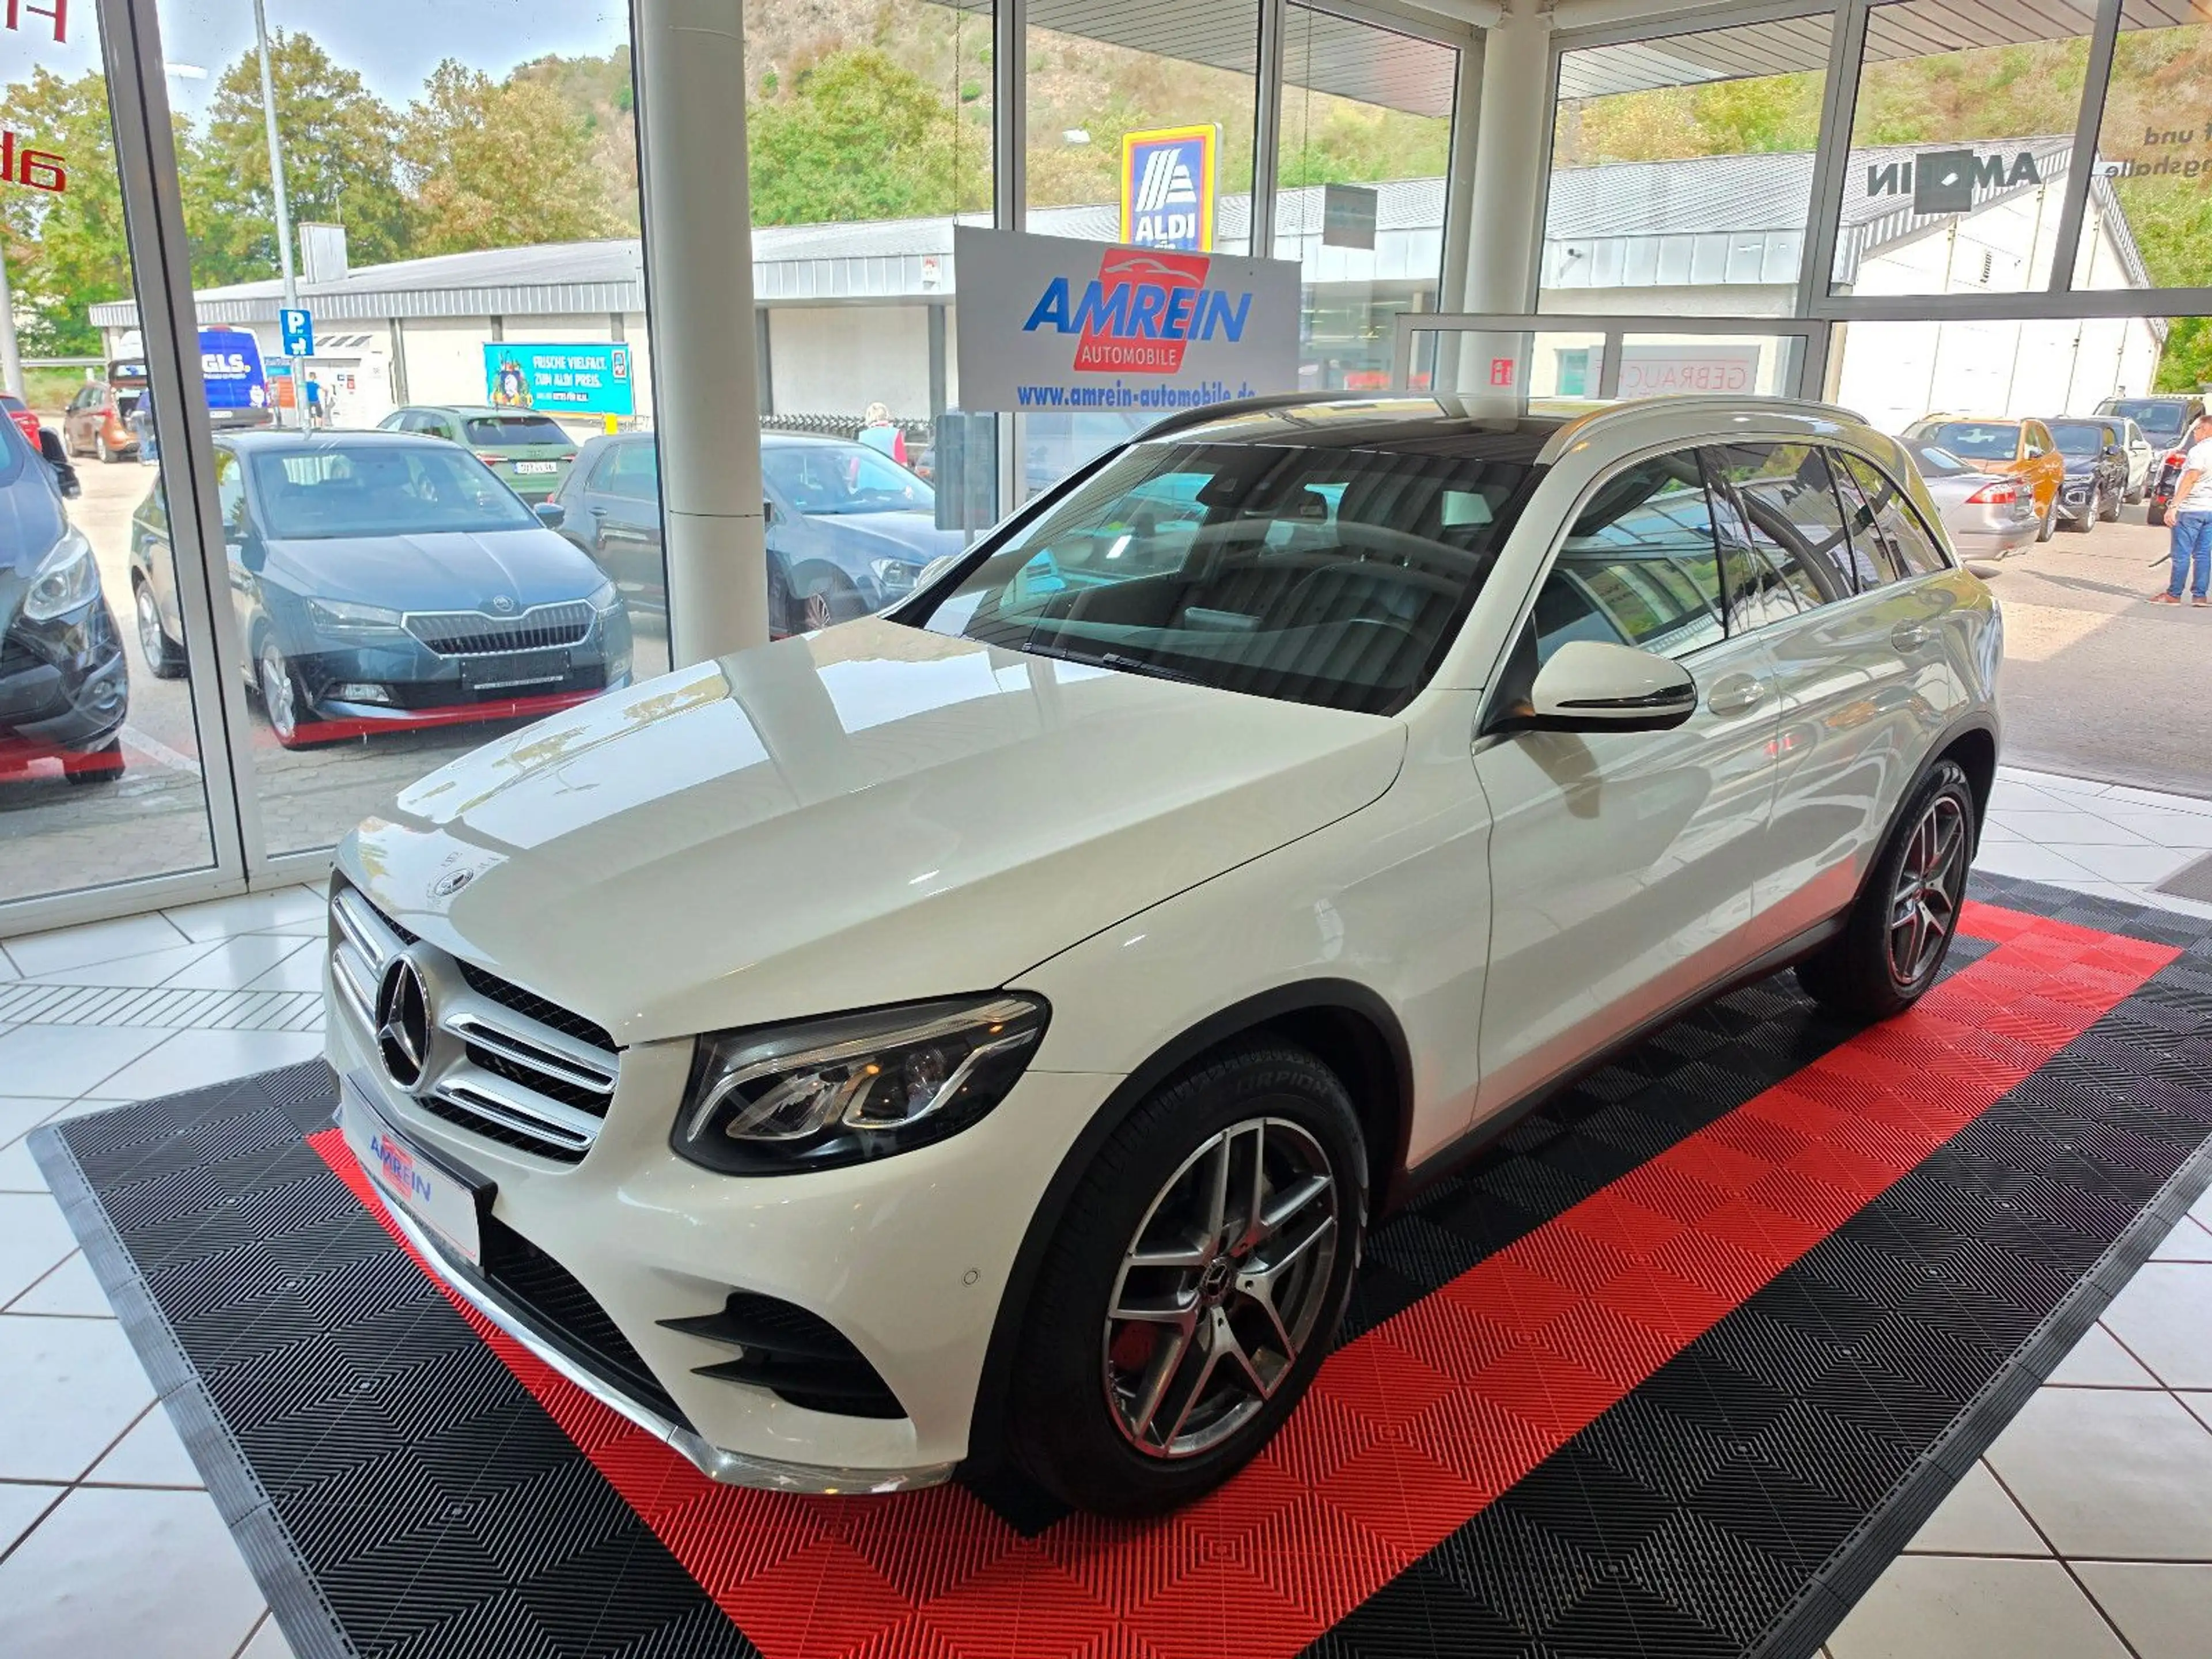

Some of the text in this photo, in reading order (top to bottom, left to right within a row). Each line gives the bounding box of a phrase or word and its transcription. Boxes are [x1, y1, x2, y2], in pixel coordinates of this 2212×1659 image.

[1135, 213, 1195, 242] ALDI
[289, 311, 305, 334] P
[1022, 276, 1252, 342] AMREIN
[1081, 346, 1177, 366] AUTOMOBILE
[1017, 380, 1256, 407] www.amrein-automobiled
[370, 1134, 431, 1202] AMREIN
